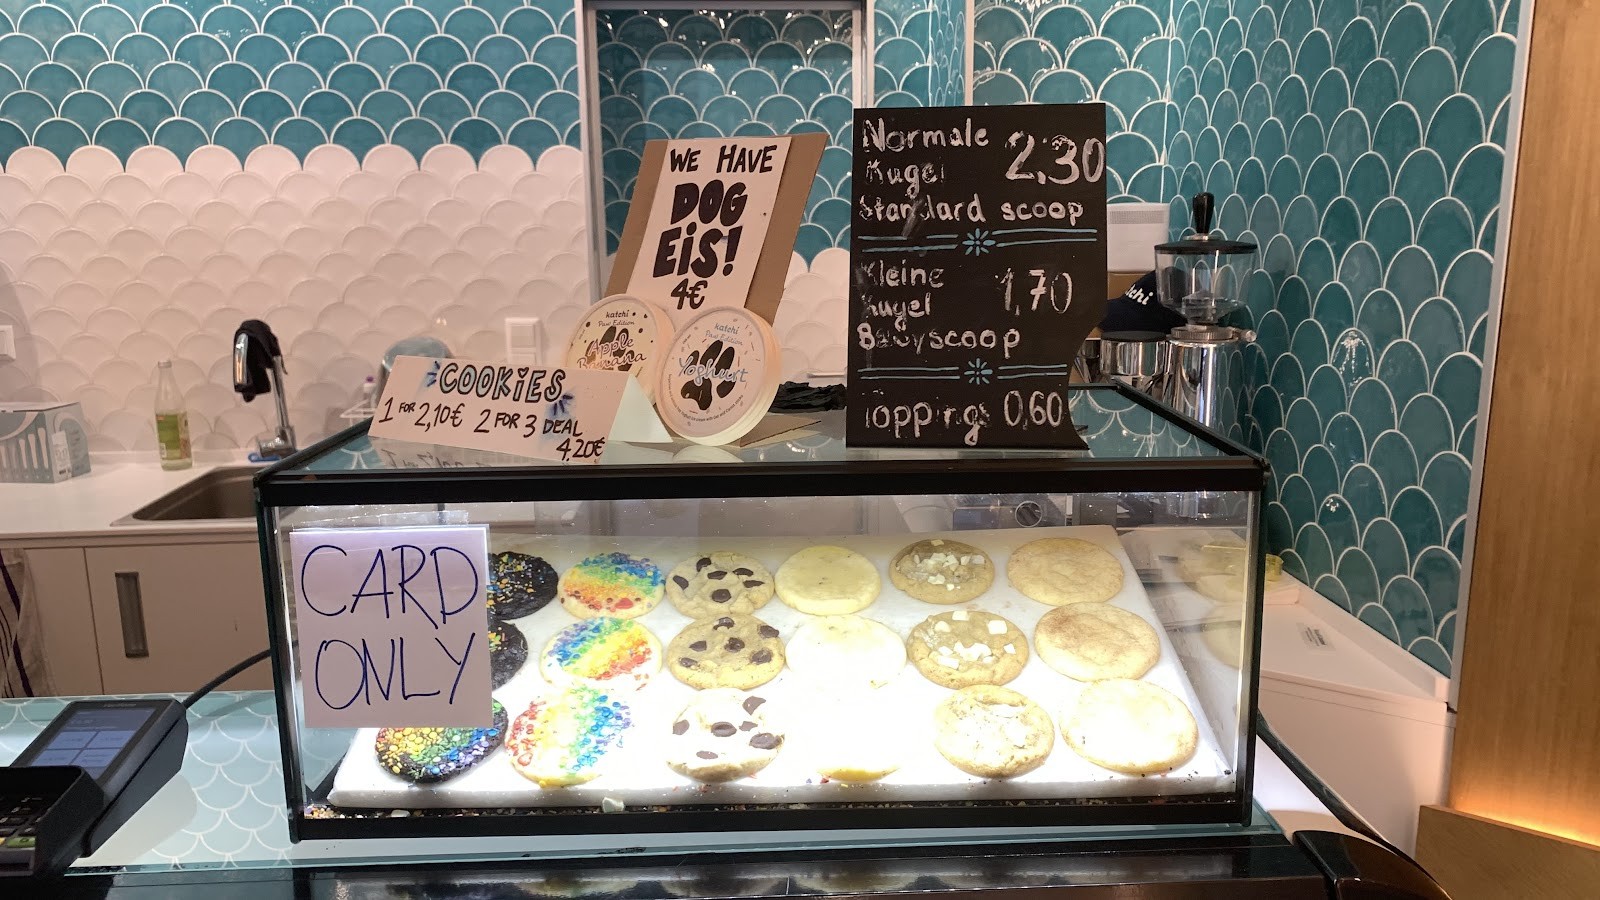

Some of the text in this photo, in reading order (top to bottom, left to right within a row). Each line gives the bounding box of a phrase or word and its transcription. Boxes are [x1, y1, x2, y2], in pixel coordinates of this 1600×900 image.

[862, 117, 989, 153] Normale
[669, 144, 778, 174] WE HAVE
[865, 158, 945, 199] Kugel
[670, 179, 748, 227] DOG
[1000, 201, 1084, 227] scoop
[670, 278, 708, 310] 4€
[605, 310, 630, 319] katchi
[714, 322, 740, 335] katchi
[577, 353, 647, 369] Banana
[588, 334, 635, 359] Apple
[678, 356, 748, 386] Yoghurt
[378, 396, 584, 438] 1 FOR 2,10€ 2 FOR 3 DEAL
[301, 544, 479, 630] CARD
[315, 632, 476, 710] ONLY
